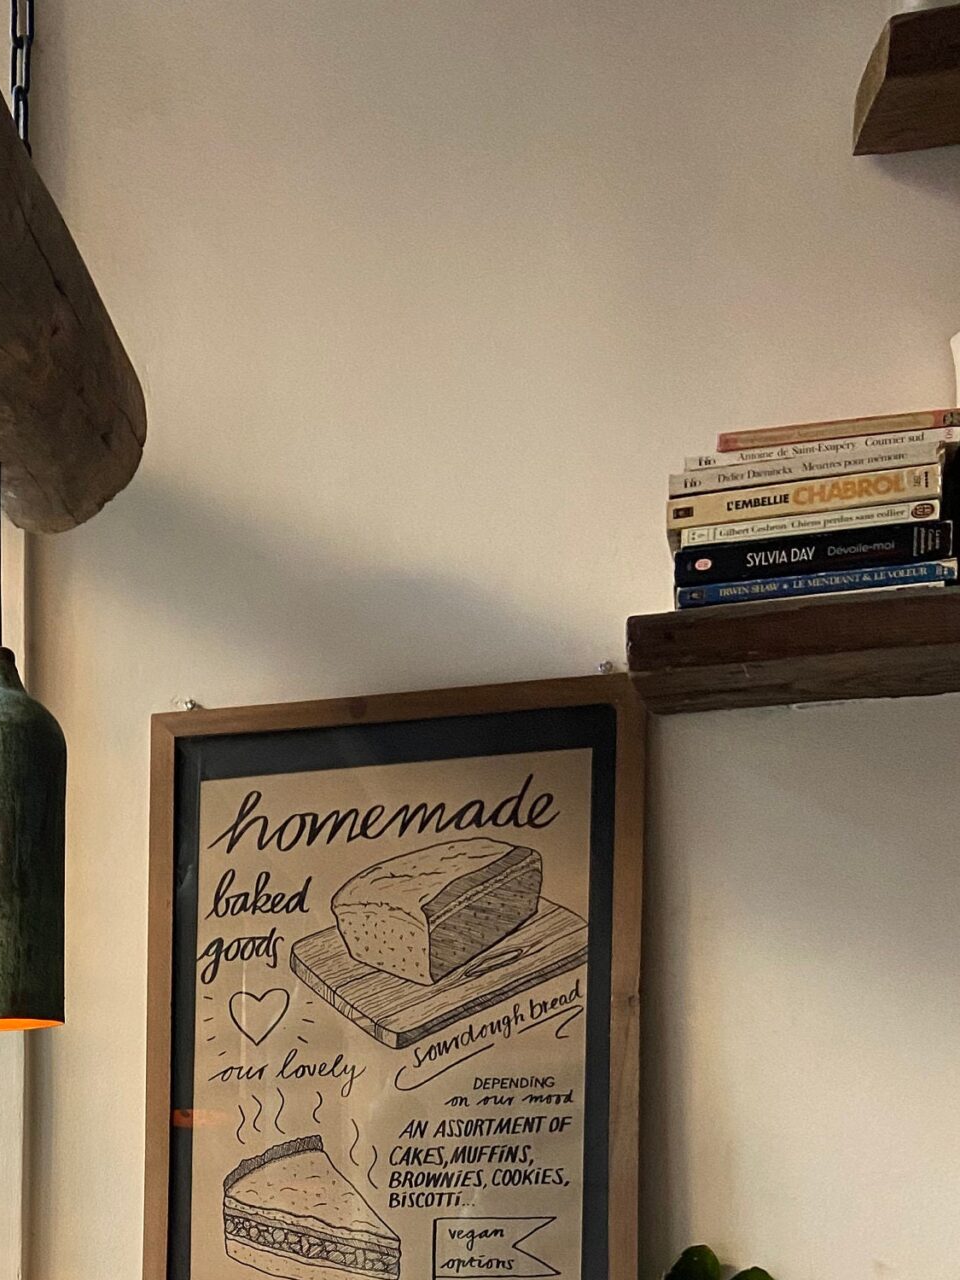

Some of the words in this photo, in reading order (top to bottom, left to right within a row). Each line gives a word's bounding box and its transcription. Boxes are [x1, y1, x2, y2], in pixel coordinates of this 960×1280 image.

[737, 451, 774, 461] Antoine
[777, 447, 789, 457] de
[908, 431, 925, 442] sud
[717, 471, 744, 483] Didier
[844, 458, 865, 470] pour
[726, 493, 790, 511] L'EMBELLIE
[792, 473, 906, 506] CHABROL
[876, 508, 906, 519] collier
[746, 549, 788, 568] SYLVIA
[790, 546, 816, 562] DAY
[719, 584, 749, 597] IRWIN
[751, 582, 780, 595] SHAW
[793, 579, 807, 589] LE
[807, 575, 860, 588] MENDIANT
[862, 573, 873, 582] &
[874, 572, 887, 581] LE
[887, 566, 929, 579] VOLEUR
[207, 773, 561, 855] homemade
[206, 869, 313, 921] baked
[197, 928, 285, 985] goods
[412, 1003, 525, 1069] sourdough
[529, 979, 584, 1020] bread
[207, 1063, 269, 1082] our
[276, 1048, 367, 1098] lovely
[444, 1095, 470, 1107] on
[476, 1095, 514, 1107] our
[521, 1089, 574, 1104] mood
[398, 1119, 429, 1139] AN
[433, 1115, 547, 1138] ASSORTMENT
[548, 1116, 573, 1133] OF
[389, 1145, 449, 1169] CAKES,
[448, 1227, 505, 1251] vegan
[440, 1255, 514, 1274] options
